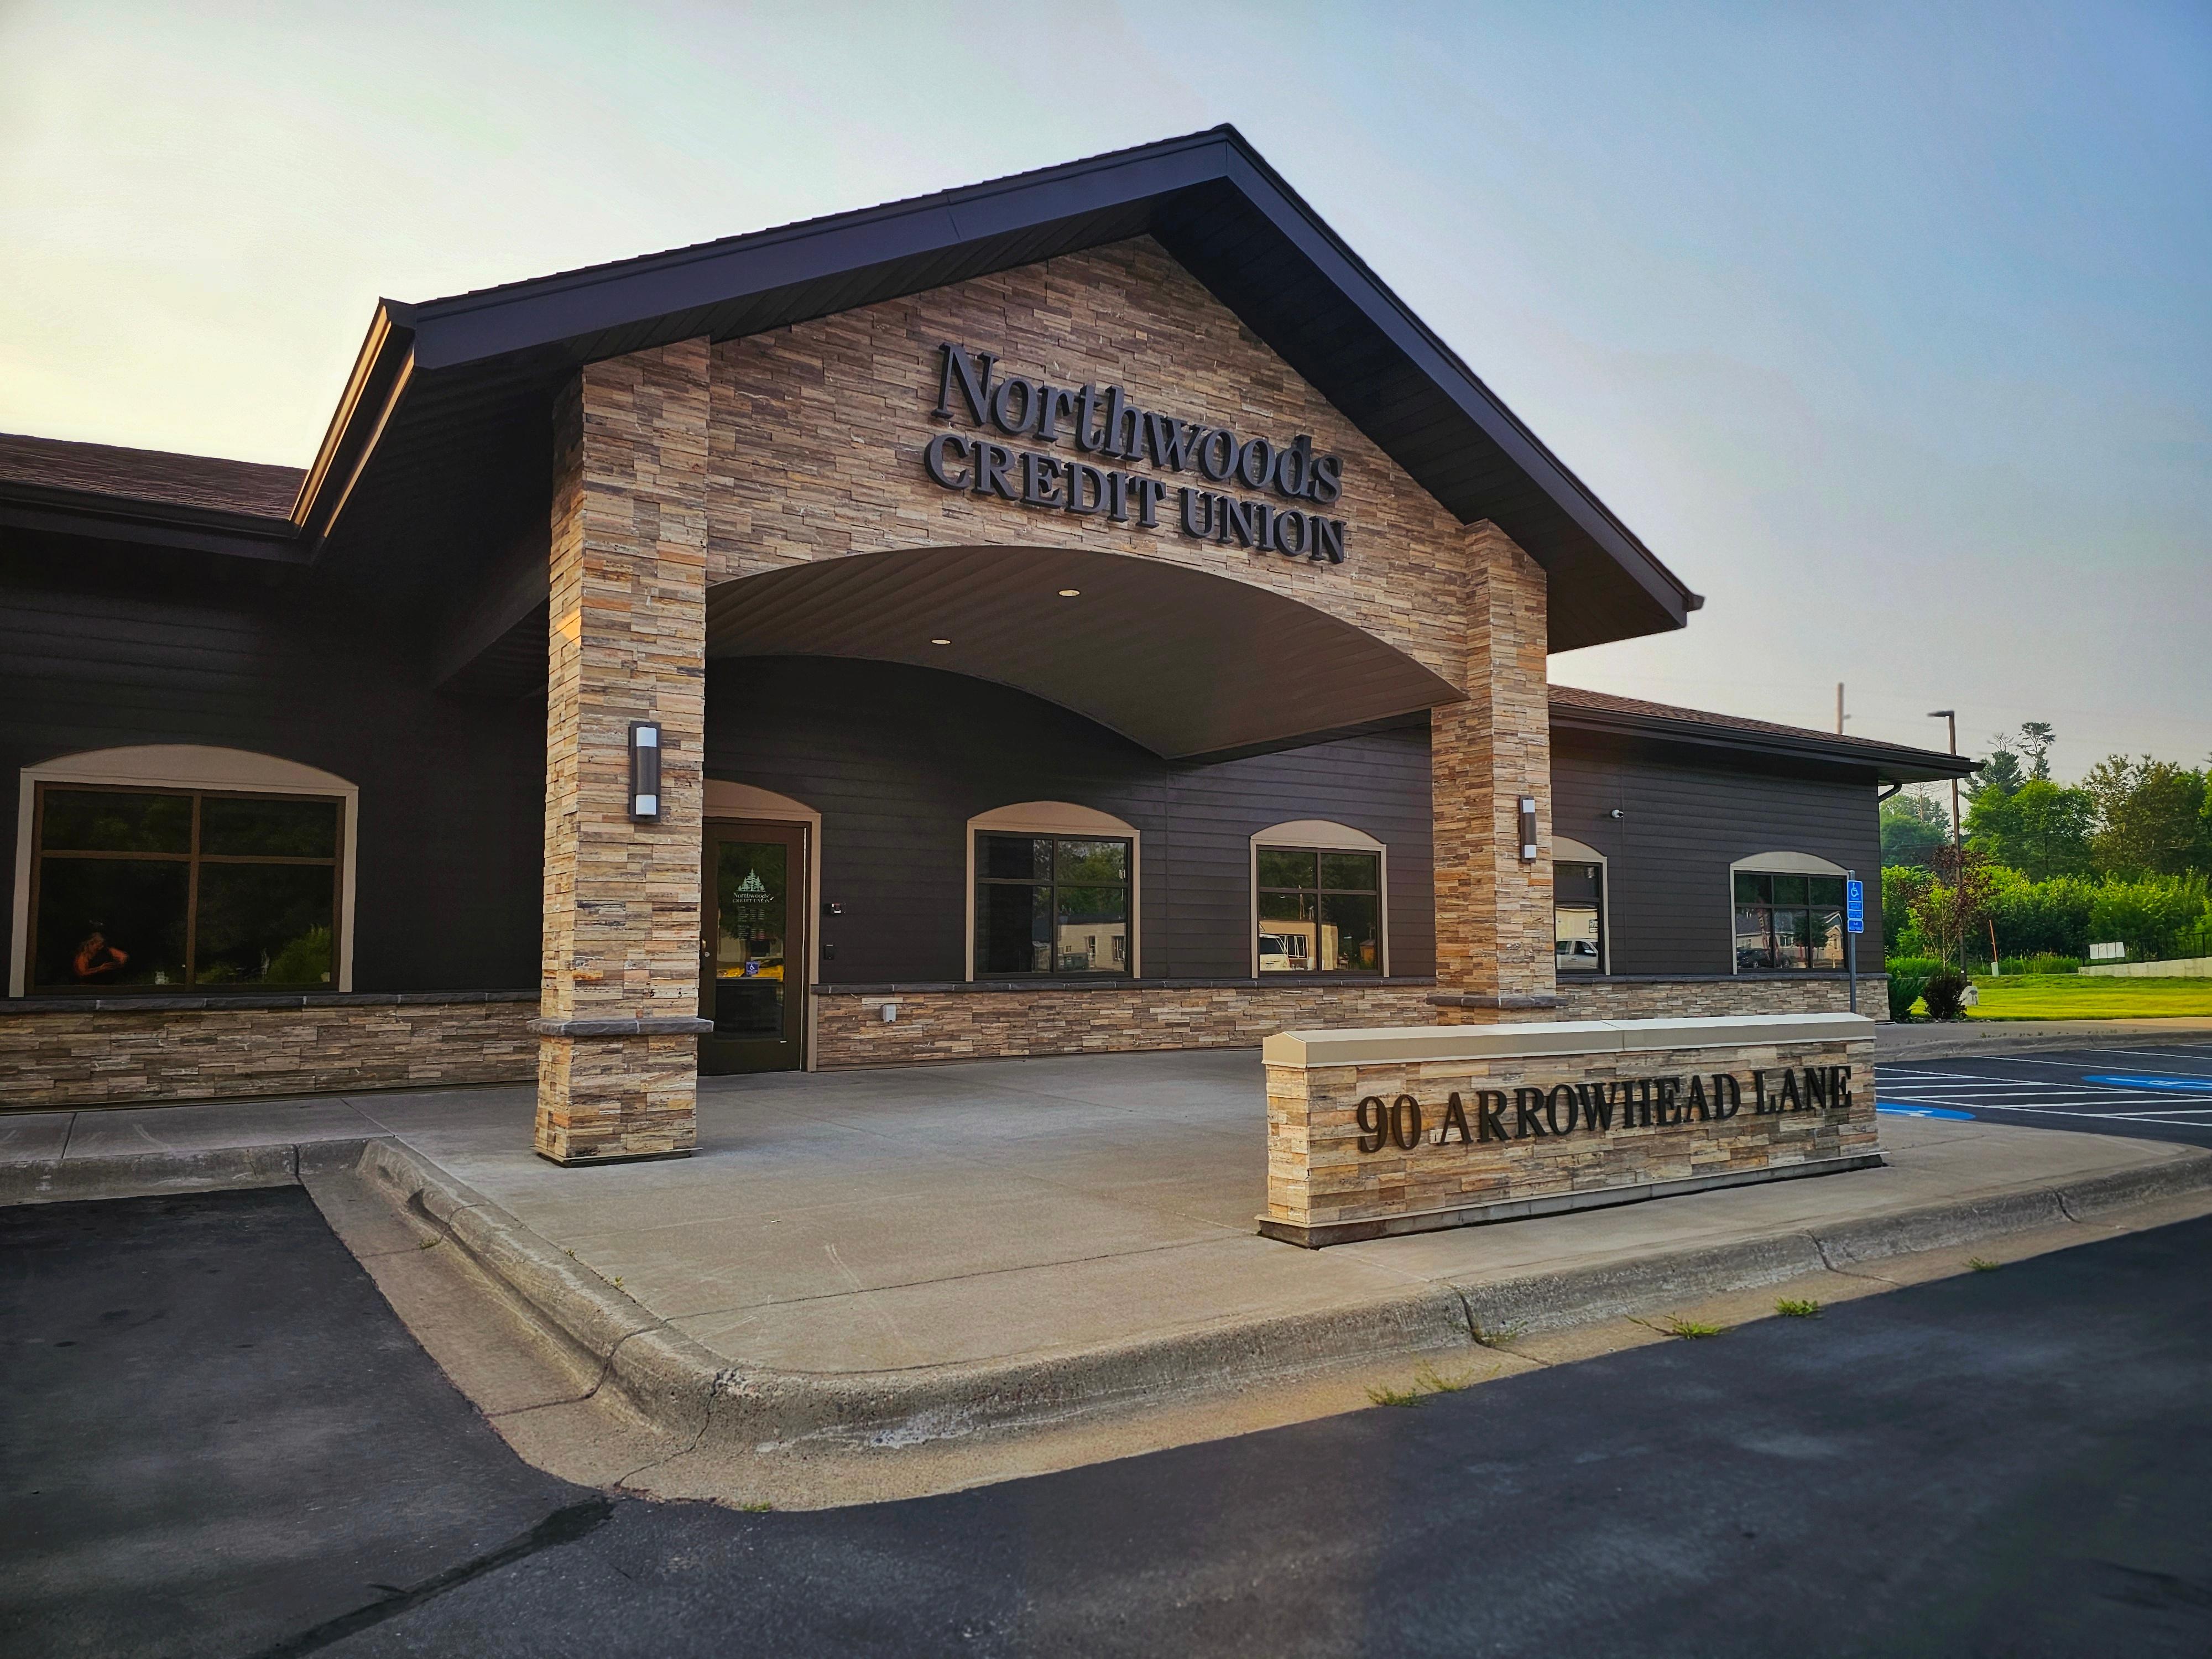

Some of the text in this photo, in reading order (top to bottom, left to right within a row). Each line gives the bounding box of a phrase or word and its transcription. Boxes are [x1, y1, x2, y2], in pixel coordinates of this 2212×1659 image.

[931, 342, 1343, 505] Northwoods
[924, 434, 1347, 565] CREDIT UNION
[1357, 1066, 1851, 1153] 90 ARROWHEAD LANE
